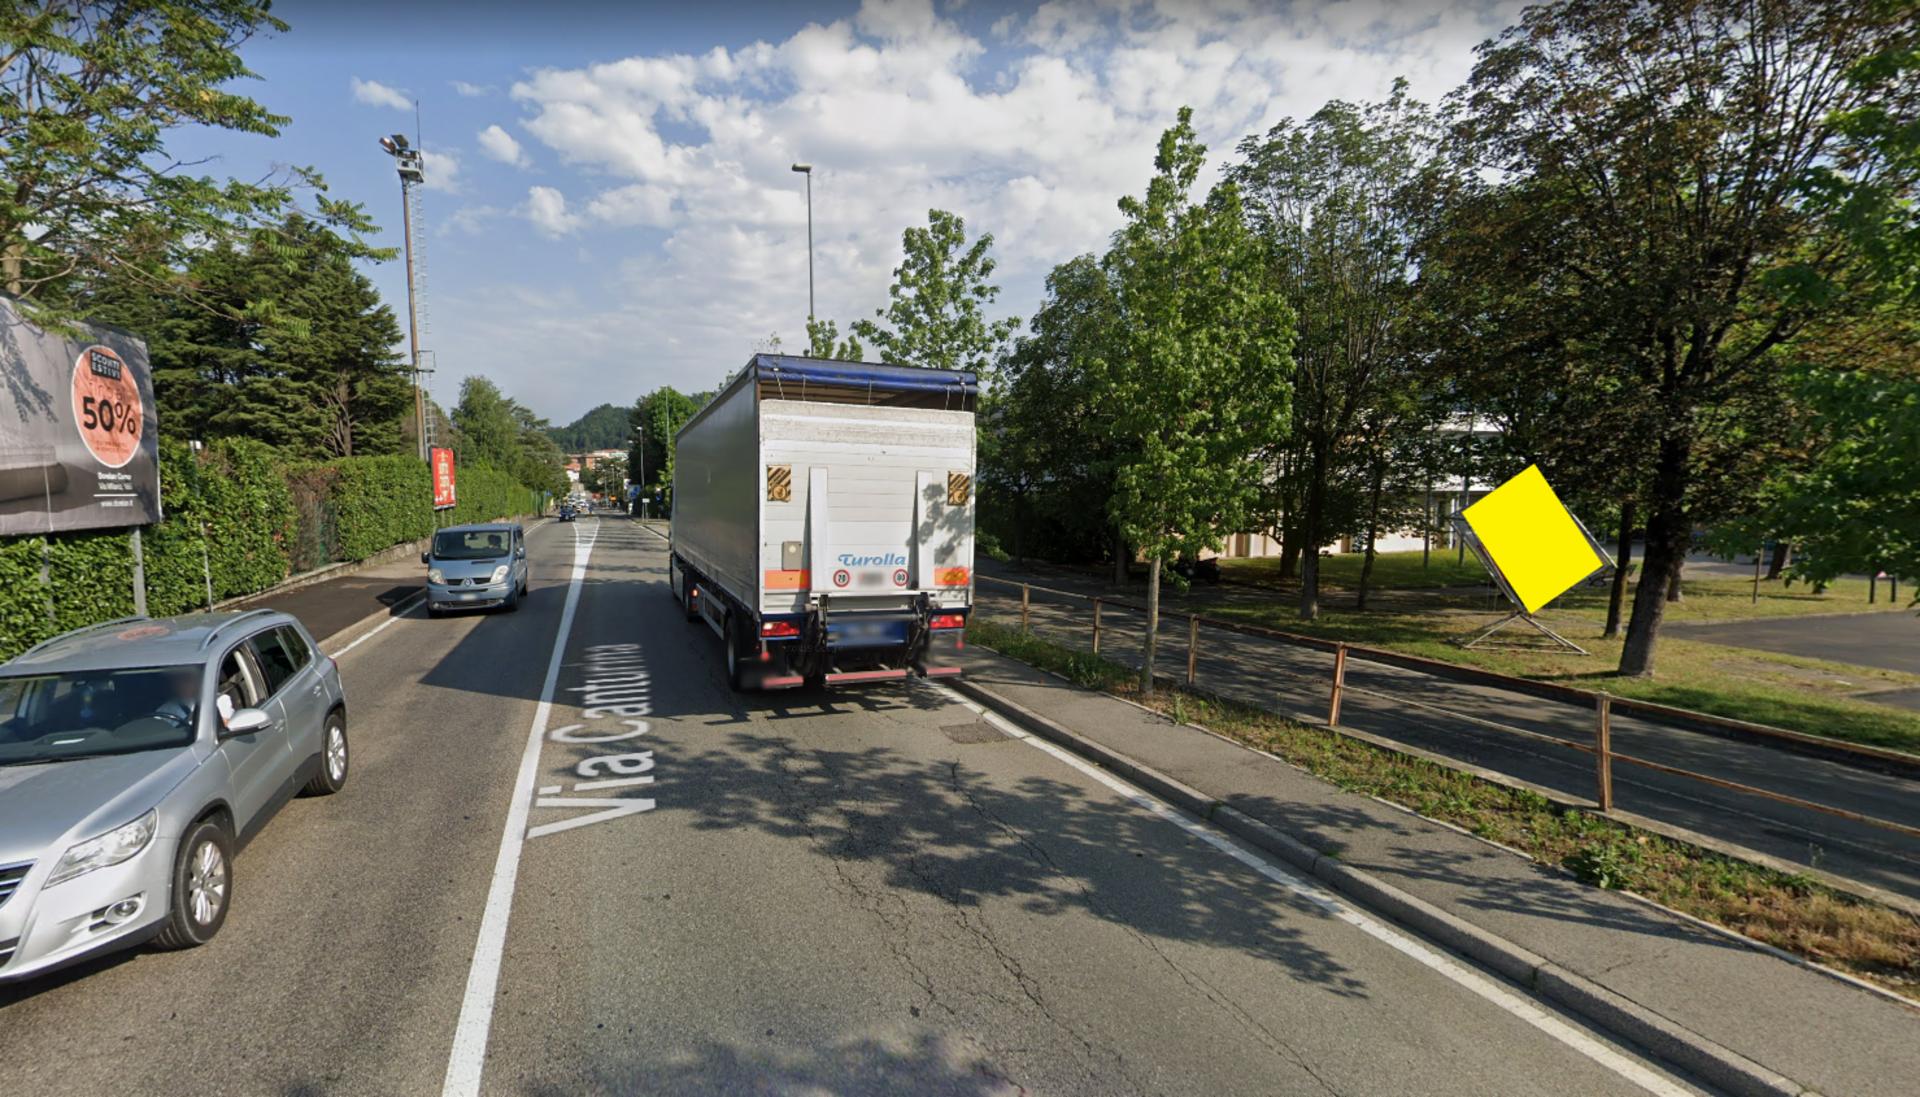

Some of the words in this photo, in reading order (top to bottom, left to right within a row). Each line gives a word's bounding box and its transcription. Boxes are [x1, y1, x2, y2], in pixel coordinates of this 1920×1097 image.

[91, 352, 120, 369] SCONTI
[91, 362, 120, 379] ESTIVI
[83, 396, 136, 434] 50%
[838, 553, 906, 567] Turolla
